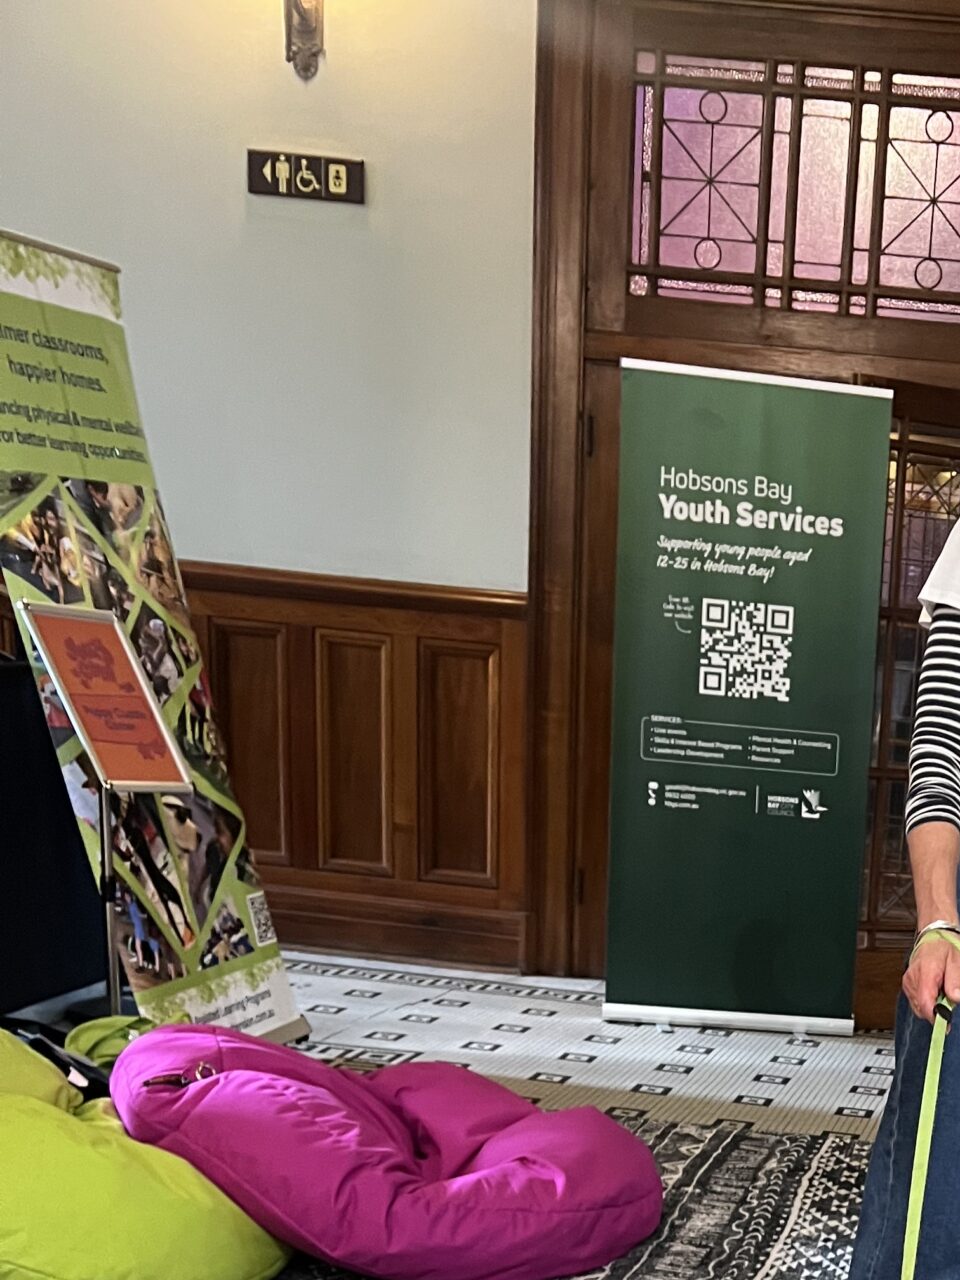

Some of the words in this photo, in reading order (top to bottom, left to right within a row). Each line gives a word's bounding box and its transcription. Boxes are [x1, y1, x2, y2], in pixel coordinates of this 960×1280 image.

[6, 353, 57, 385] happier
[660, 466, 748, 496] Hobsons
[754, 476, 792, 505] Bay
[658, 493, 730, 525] Youth
[736, 501, 844, 537] Services
[656, 534, 712, 557] Supporting
[714, 543, 746, 560] young
[745, 545, 782, 562] people
[782, 548, 813, 567] aged
[656, 555, 689, 570] 12-25
[690, 557, 702, 571] in
[703, 559, 746, 575] Hobsons
[747, 563, 775, 585] Bay!
